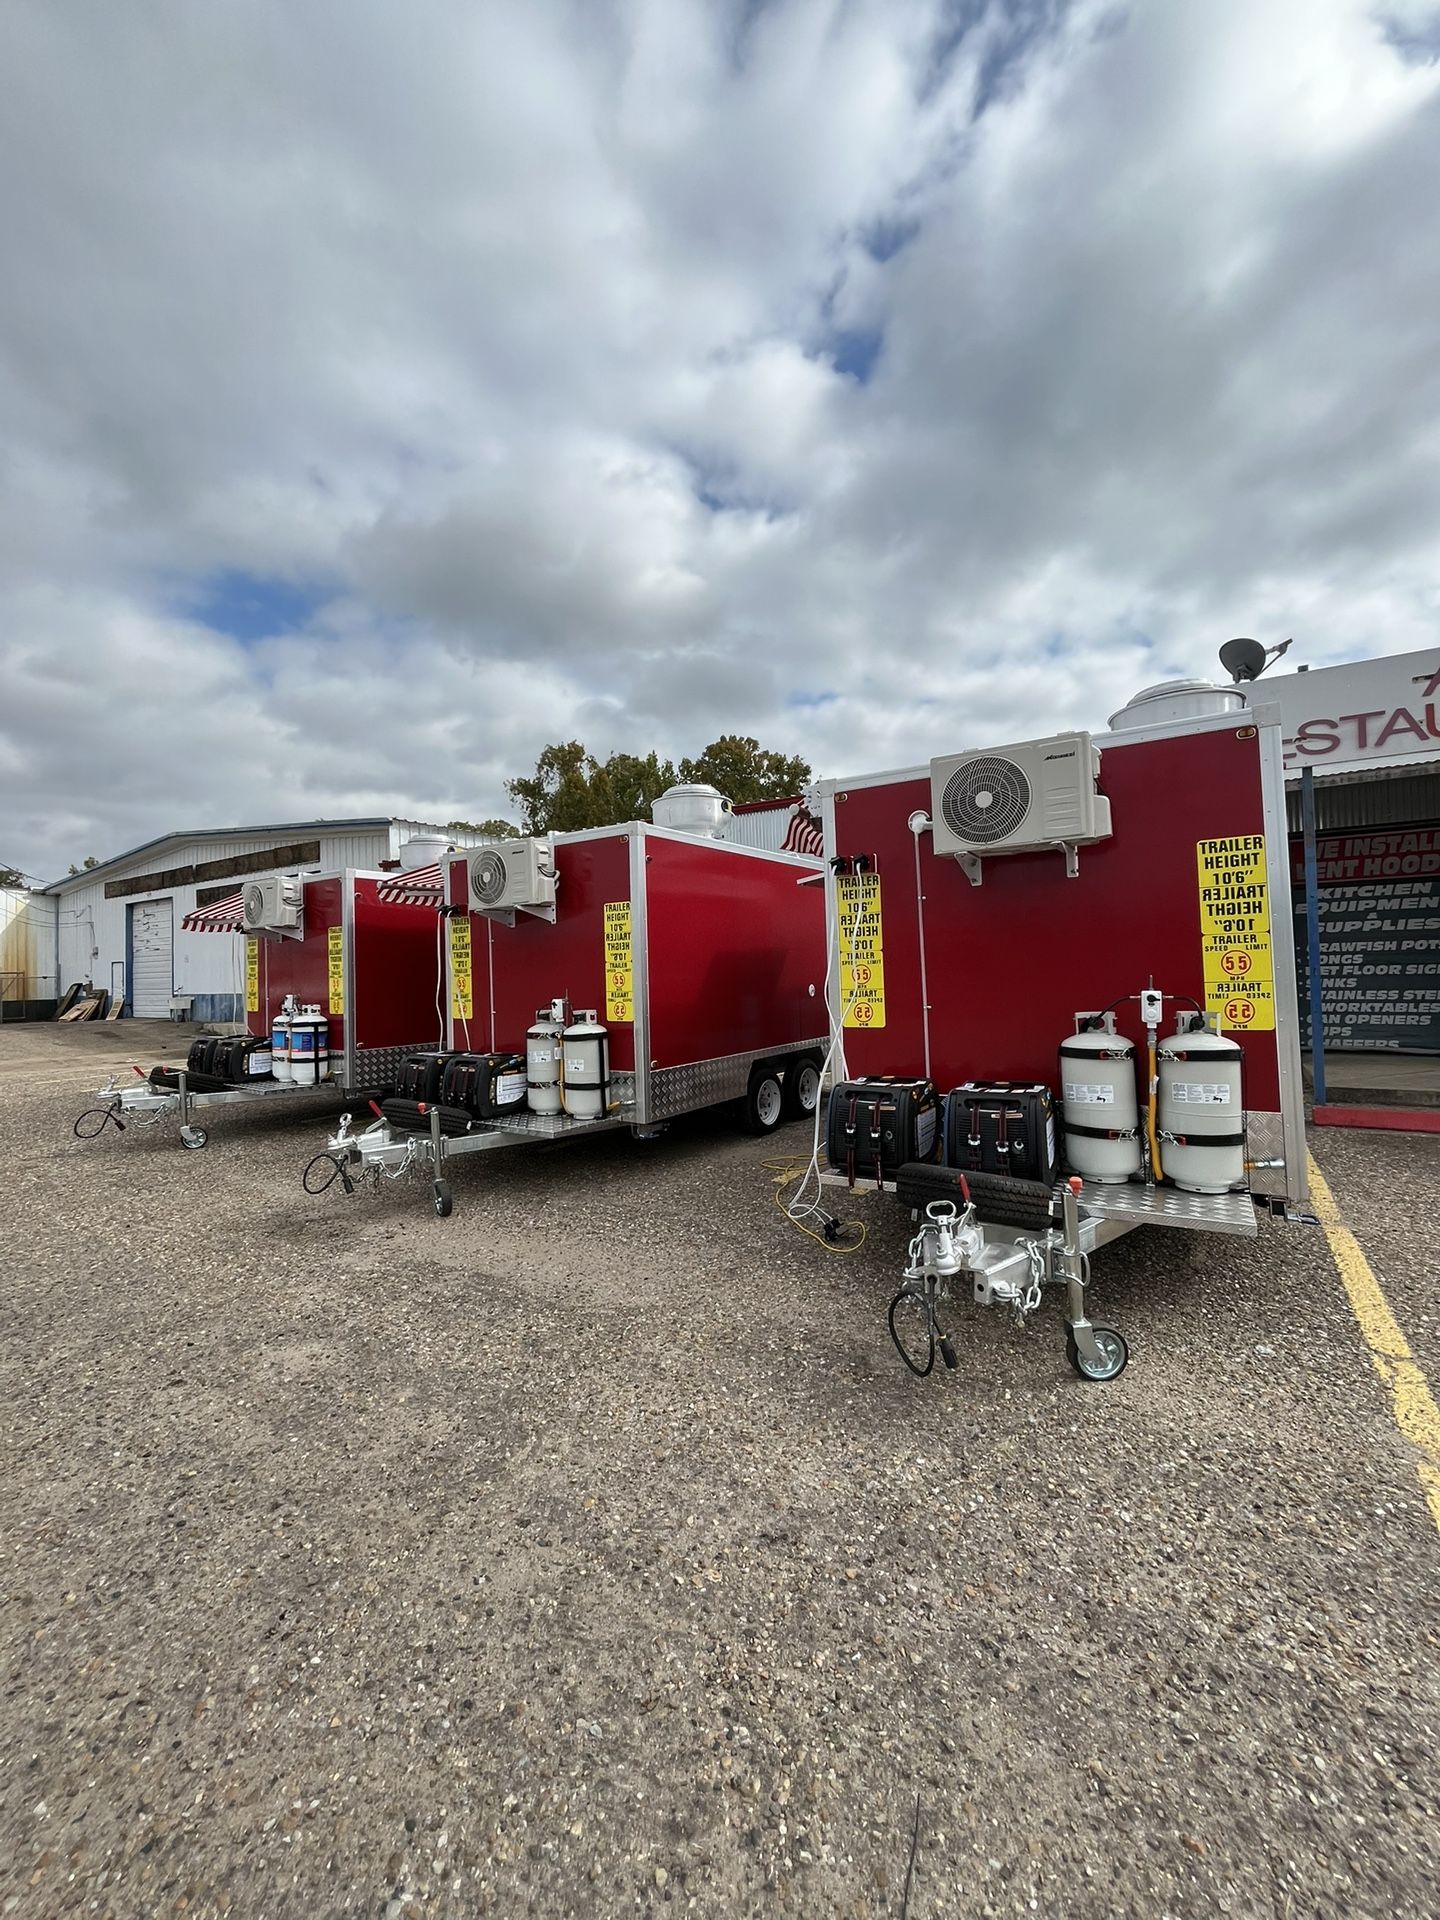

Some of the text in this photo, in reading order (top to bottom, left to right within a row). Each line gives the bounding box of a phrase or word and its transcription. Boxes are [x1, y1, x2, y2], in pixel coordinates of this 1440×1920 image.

[1199, 836, 1263, 854] TRAILER
[1205, 852, 1260, 869] HEIGHT
[839, 875, 879, 888] TRAILER
[1317, 882, 1433, 899] KITCHEN
[605, 903, 630, 912] TRAILER
[607, 912, 629, 921] HEIGHT
[1212, 934, 1257, 945] TRAILER
[1245, 943, 1268, 951] LIMIT
[1307, 939, 1440, 953] RAWFISH POT
[1225, 956, 1247, 971] 55
[1307, 954, 1364, 965] ONGS
[1342, 964, 1402, 976] FLOOR
[1405, 964, 1440, 975] SIG
[614, 975, 624, 985] 55
[1402, 990, 1440, 1000] STE
[1321, 1002, 1440, 1013] WORKTABLES
[1344, 1014, 1432, 1025] OPENERS
